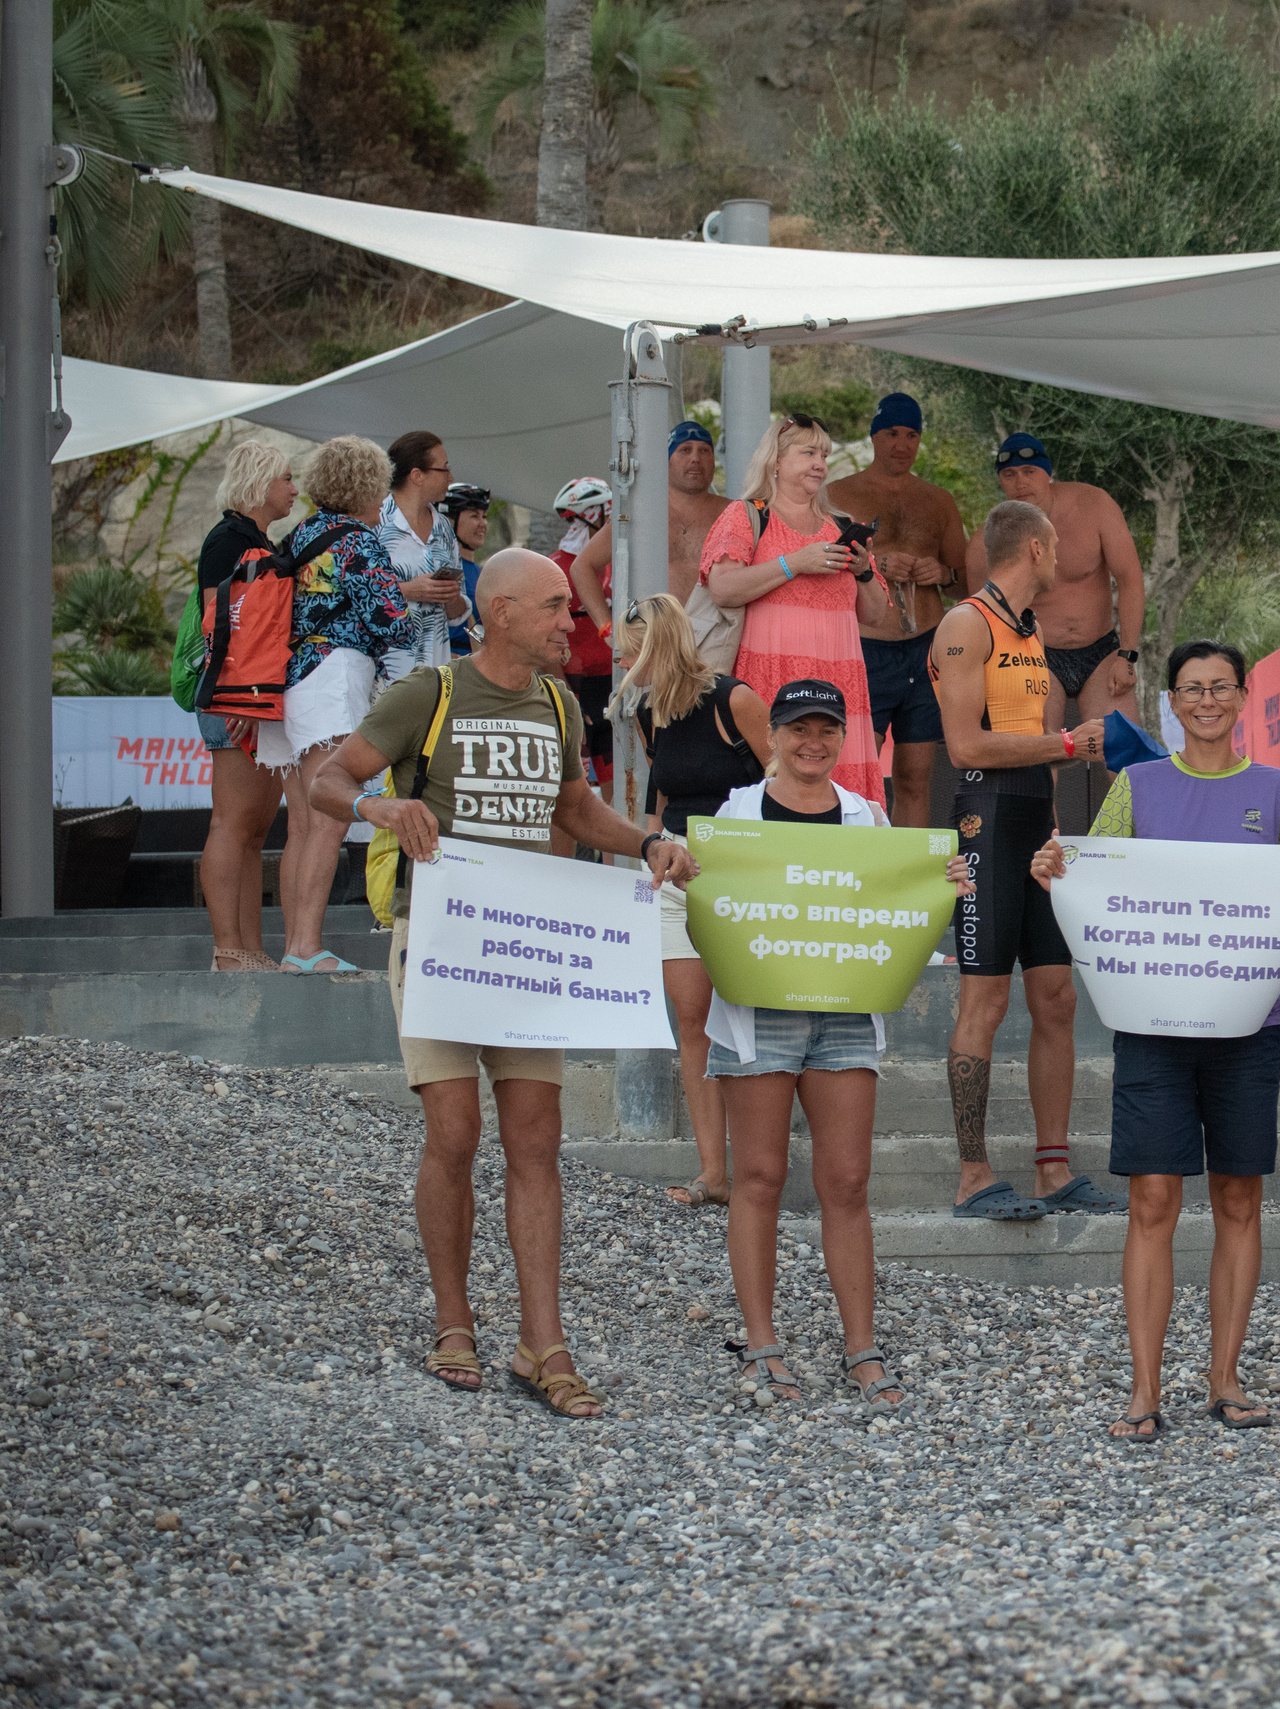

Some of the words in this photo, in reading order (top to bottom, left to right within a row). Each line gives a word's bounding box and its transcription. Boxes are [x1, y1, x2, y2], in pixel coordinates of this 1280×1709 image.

[947, 647, 964, 656] 209
[455, 720, 519, 731] ORIGINAL
[1088, 736, 1096, 755] 209
[451, 734, 561, 780] TRUE
[136, 761, 213, 786] THLO
[493, 782, 546, 792] MUSTANG
[443, 853, 467, 863] SHARUN
[467, 858, 484, 866] TEAM
[786, 864, 863, 892] Беги,
[714, 896, 799, 922] будто
[807, 905, 929, 928] впереди
[1107, 895, 1192, 916] Sharun
[1199, 899, 1271, 919] Team:
[446, 898, 476, 918] Не
[482, 907, 596, 939] многовато
[602, 928, 631, 945] ли
[1083, 925, 1155, 946] Когда
[1163, 932, 1200, 947] мы
[482, 939, 563, 965] работы
[569, 953, 593, 969] за
[749, 934, 892, 965] фотограф
[1096, 956, 1136, 975] Мы
[421, 958, 562, 996] бесплатный
[568, 981, 651, 1005] банан?
[785, 992, 850, 1004] sharun.team
[1150, 1018, 1216, 1029] sharun.team
[504, 1030, 570, 1043] sharun.team
